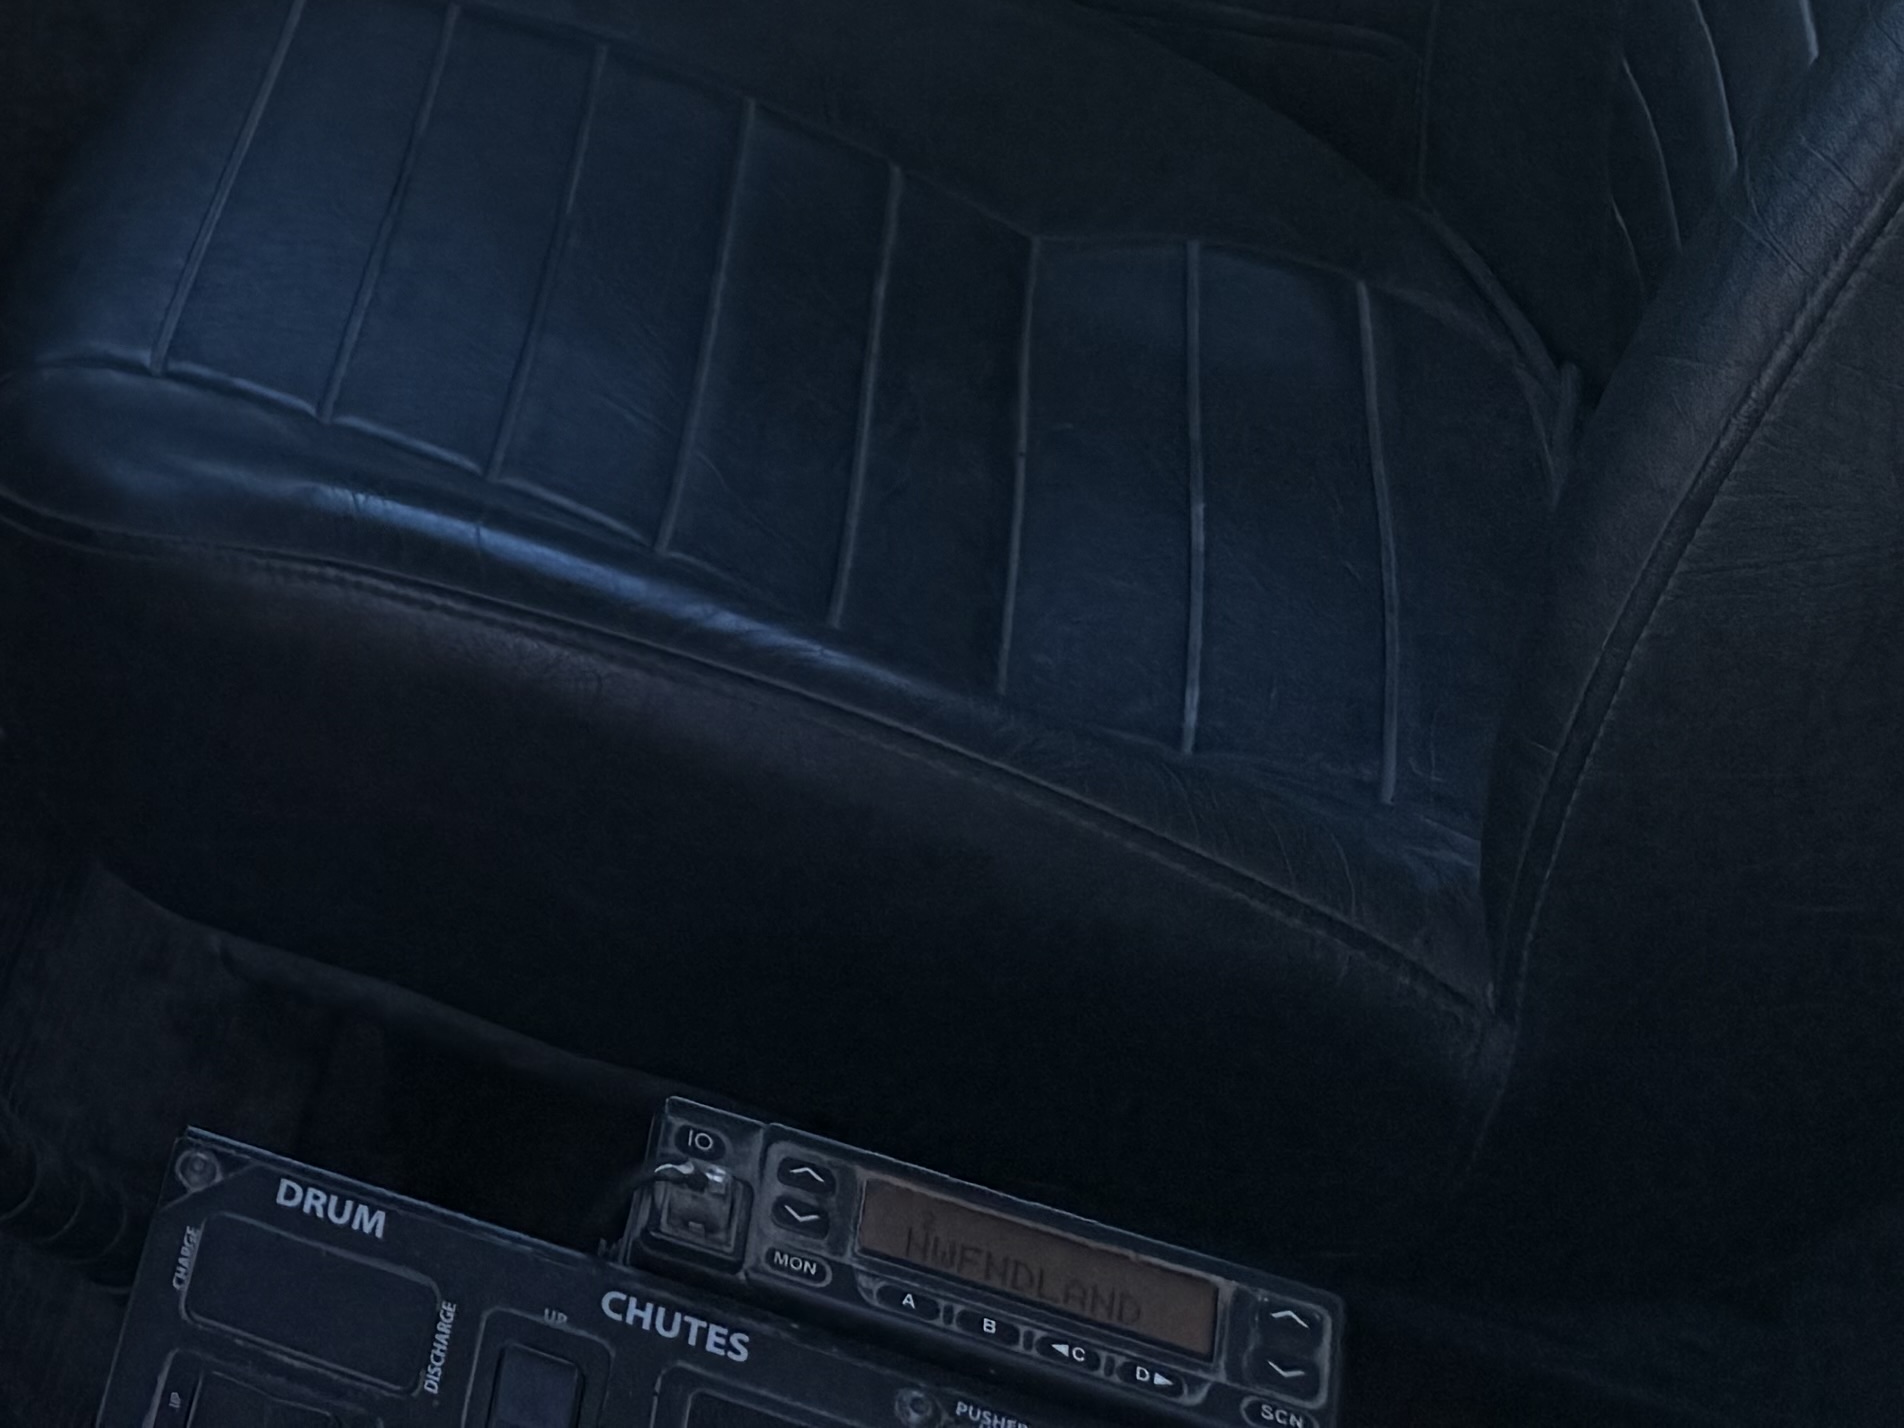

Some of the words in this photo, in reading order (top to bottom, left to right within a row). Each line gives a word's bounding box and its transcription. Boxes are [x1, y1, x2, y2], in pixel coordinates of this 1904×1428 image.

[275, 1177, 386, 1240] DRUM
[172, 1225, 198, 1291] CHARGE
[772, 1251, 818, 1277] MON
[423, 1300, 457, 1395] DISCHARGE
[599, 1290, 752, 1363] CHUTES
[901, 1293, 917, 1310] A
[982, 1317, 998, 1335] B
[1071, 1346, 1087, 1363] C
[1135, 1364, 1151, 1384] D
[1260, 1403, 1304, 1428] SCN
